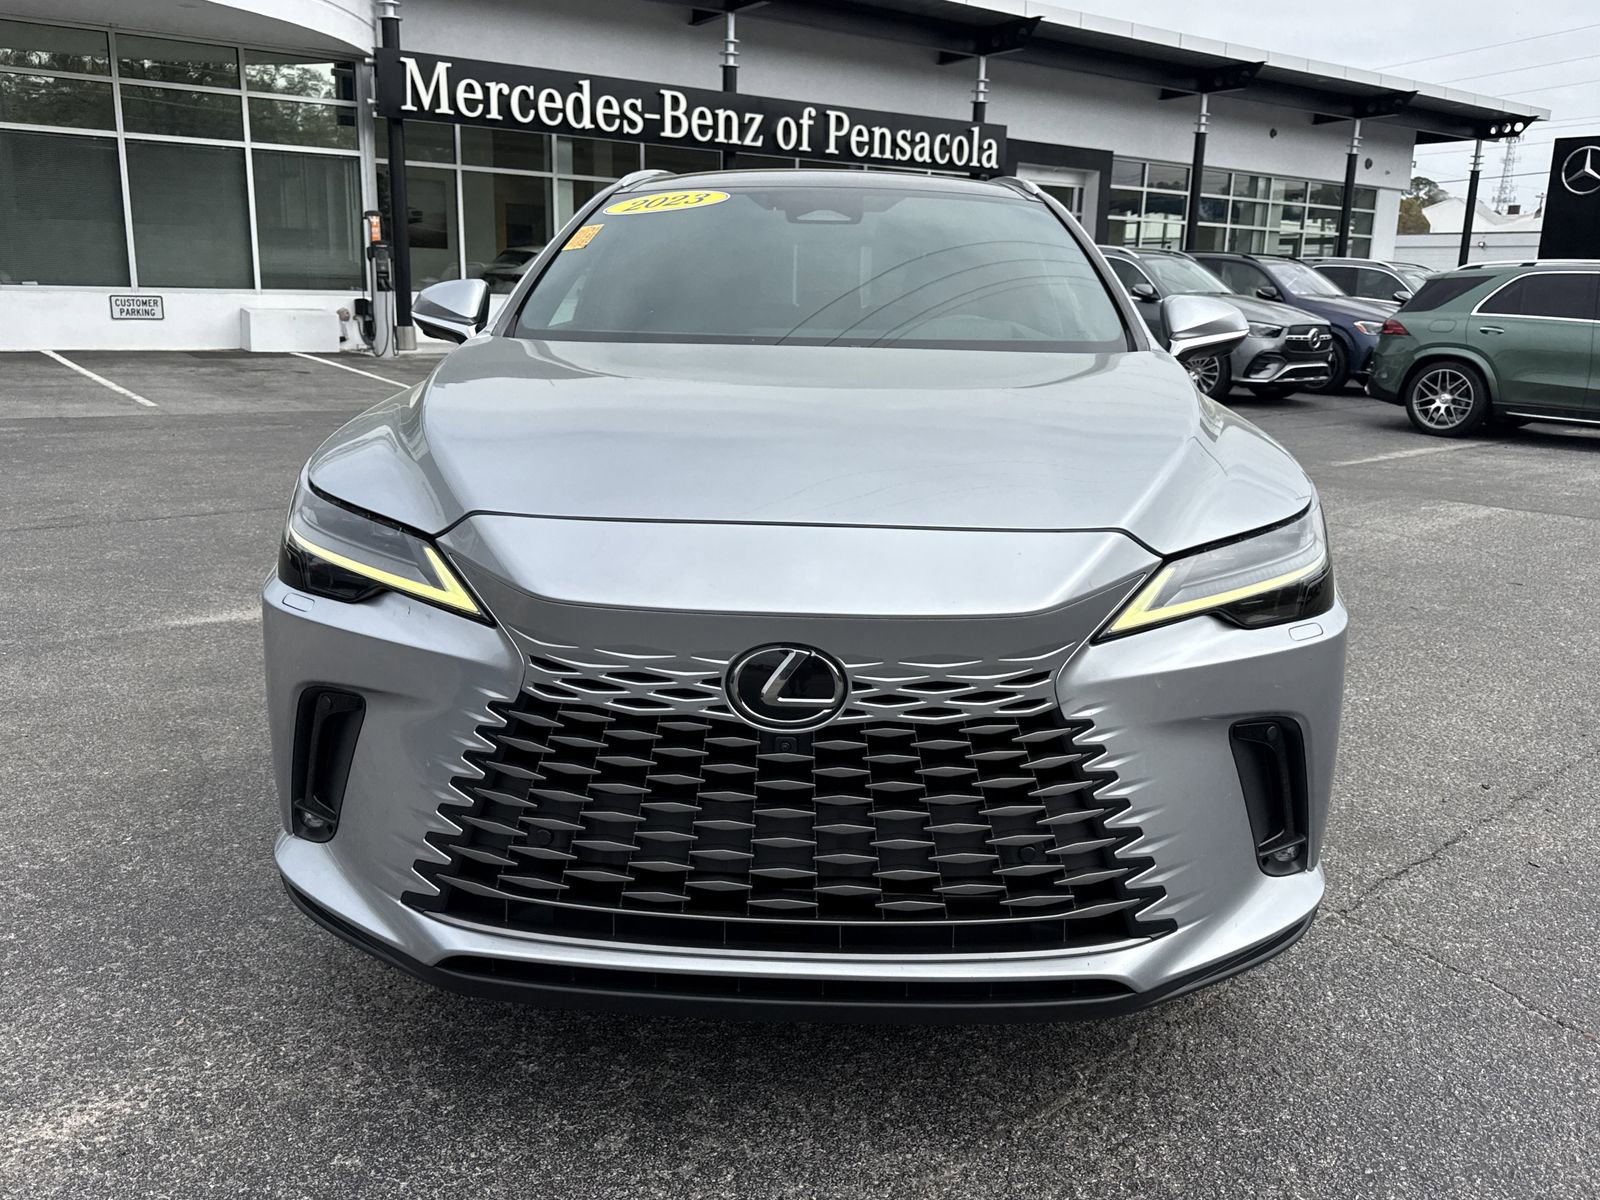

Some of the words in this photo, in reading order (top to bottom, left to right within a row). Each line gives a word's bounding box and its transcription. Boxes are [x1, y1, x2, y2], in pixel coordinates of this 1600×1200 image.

[400, 56, 764, 147] Mercedes-Benz
[776, 107, 816, 151] of
[825, 110, 999, 169] Pensacola
[623, 193, 711, 212] 2023
[114, 298, 159, 307] CUSTOMER
[119, 307, 156, 317] PARKING
